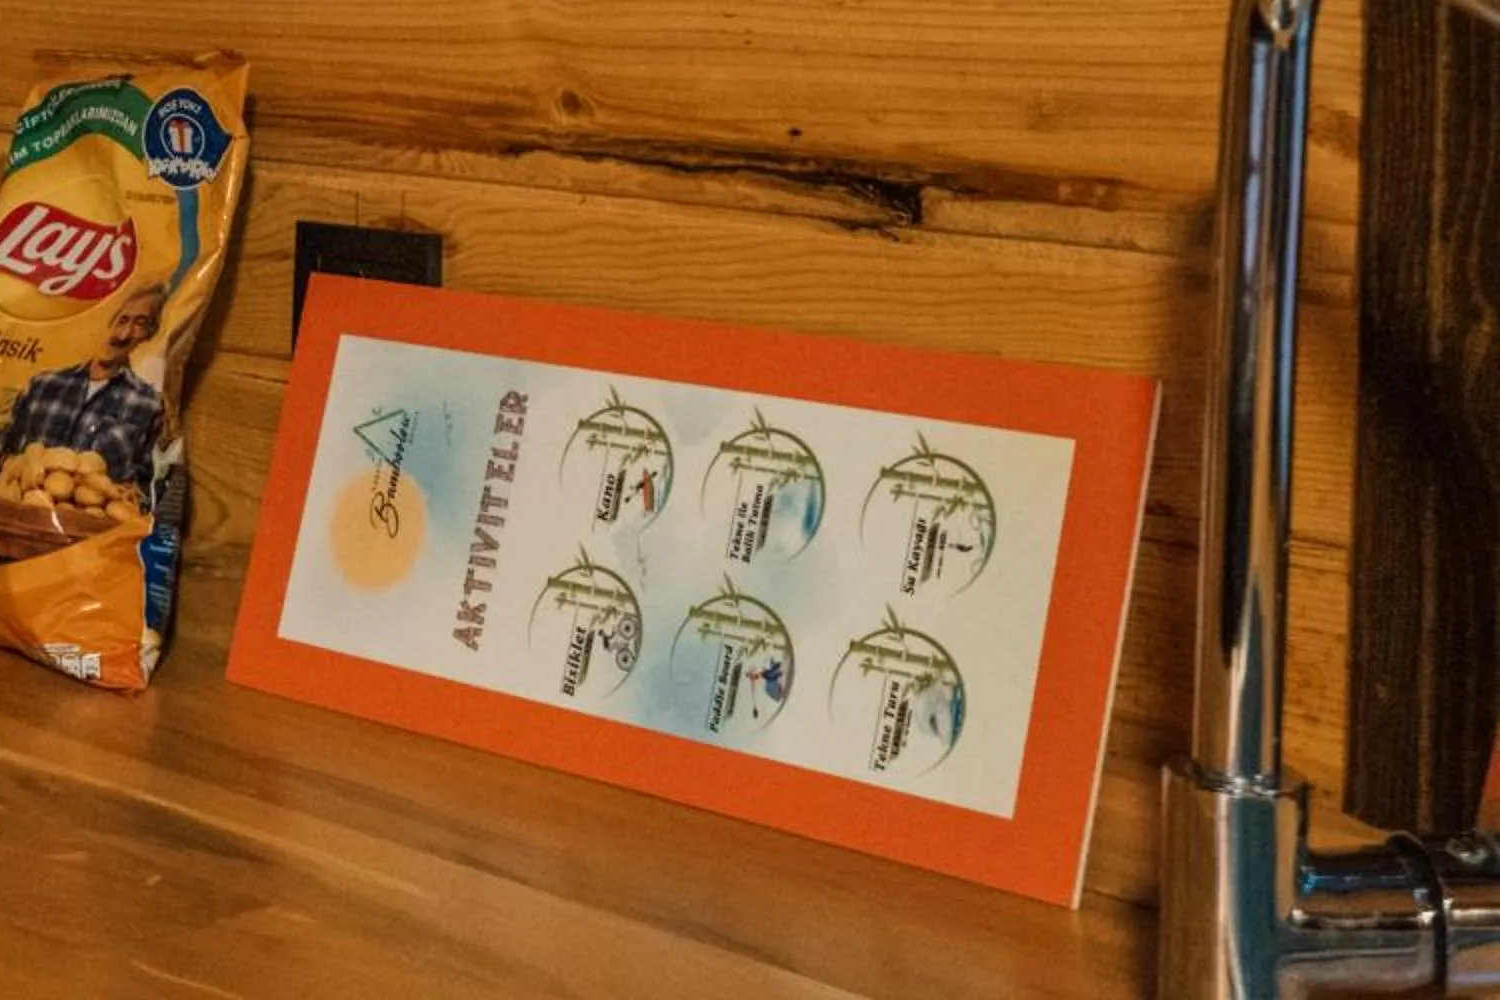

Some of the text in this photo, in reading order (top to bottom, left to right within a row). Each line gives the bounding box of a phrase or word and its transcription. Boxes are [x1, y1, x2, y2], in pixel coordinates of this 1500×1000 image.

[597, 473, 615, 521] Kano
[729, 522, 744, 559] Tekne
[903, 576, 916, 597] Su
[563, 625, 587, 697] Bisiklet
[874, 681, 900, 770] Tekne Turu
